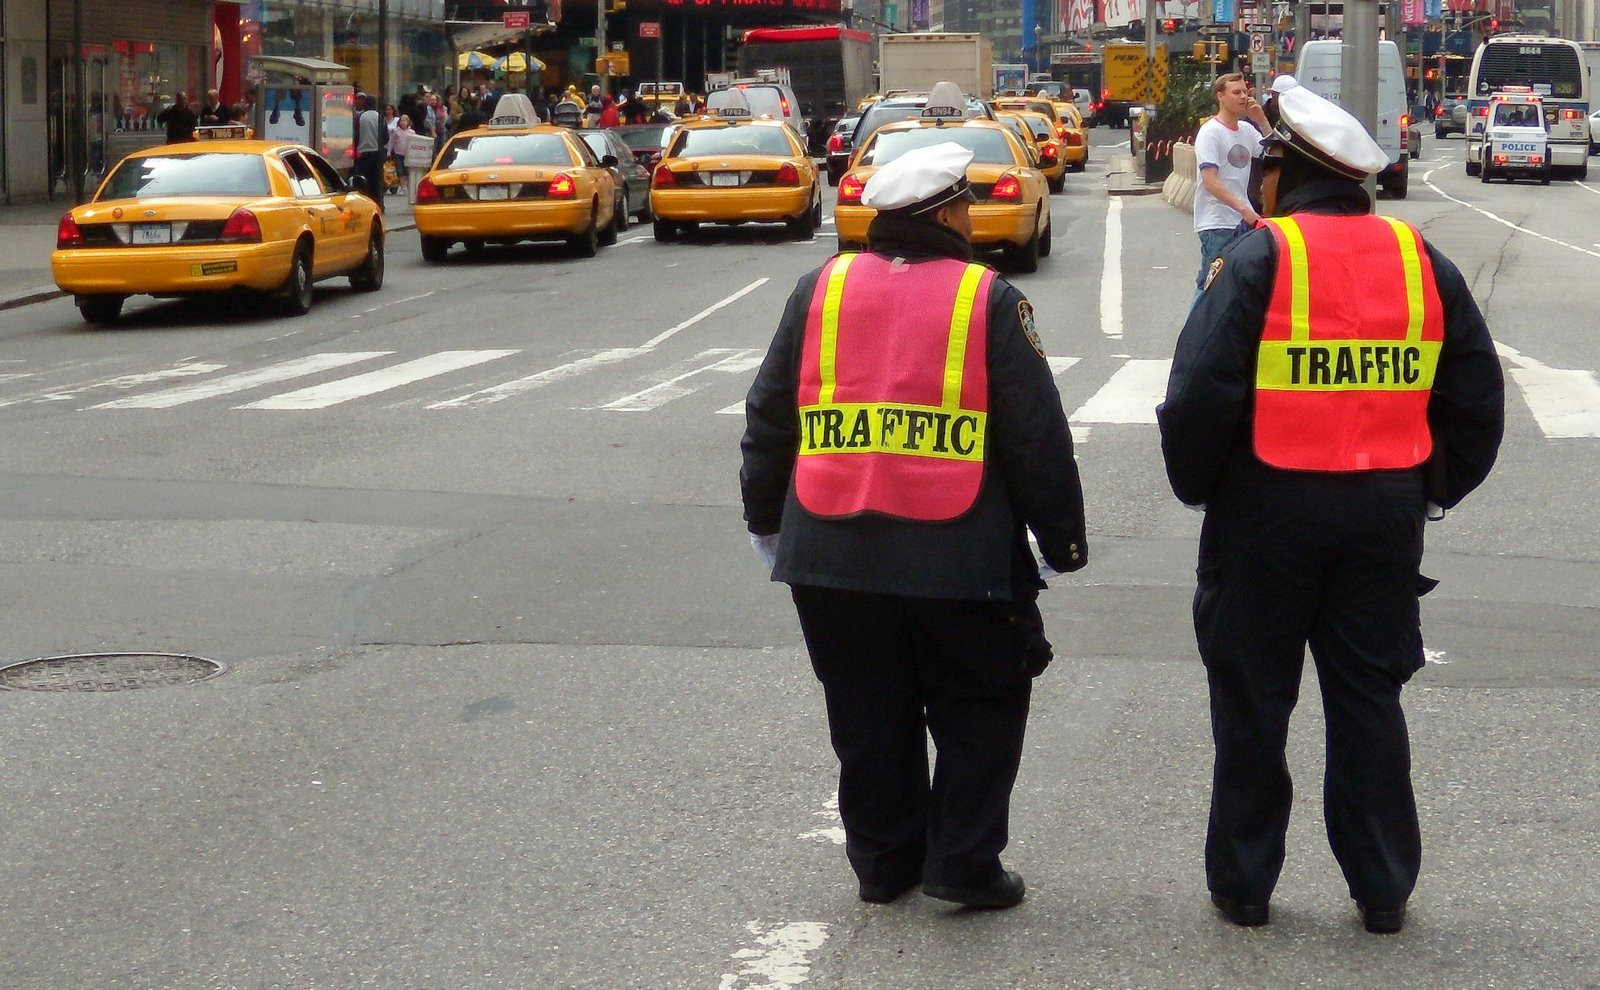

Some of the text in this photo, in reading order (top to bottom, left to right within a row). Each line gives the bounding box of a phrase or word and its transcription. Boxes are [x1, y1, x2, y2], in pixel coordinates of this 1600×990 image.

[1519, 46, 1541, 55] 8644
[1501, 143, 1537, 152] POLICE
[1286, 346, 1420, 385] TRAFFIC
[804, 407, 978, 456] TRAFFIC
